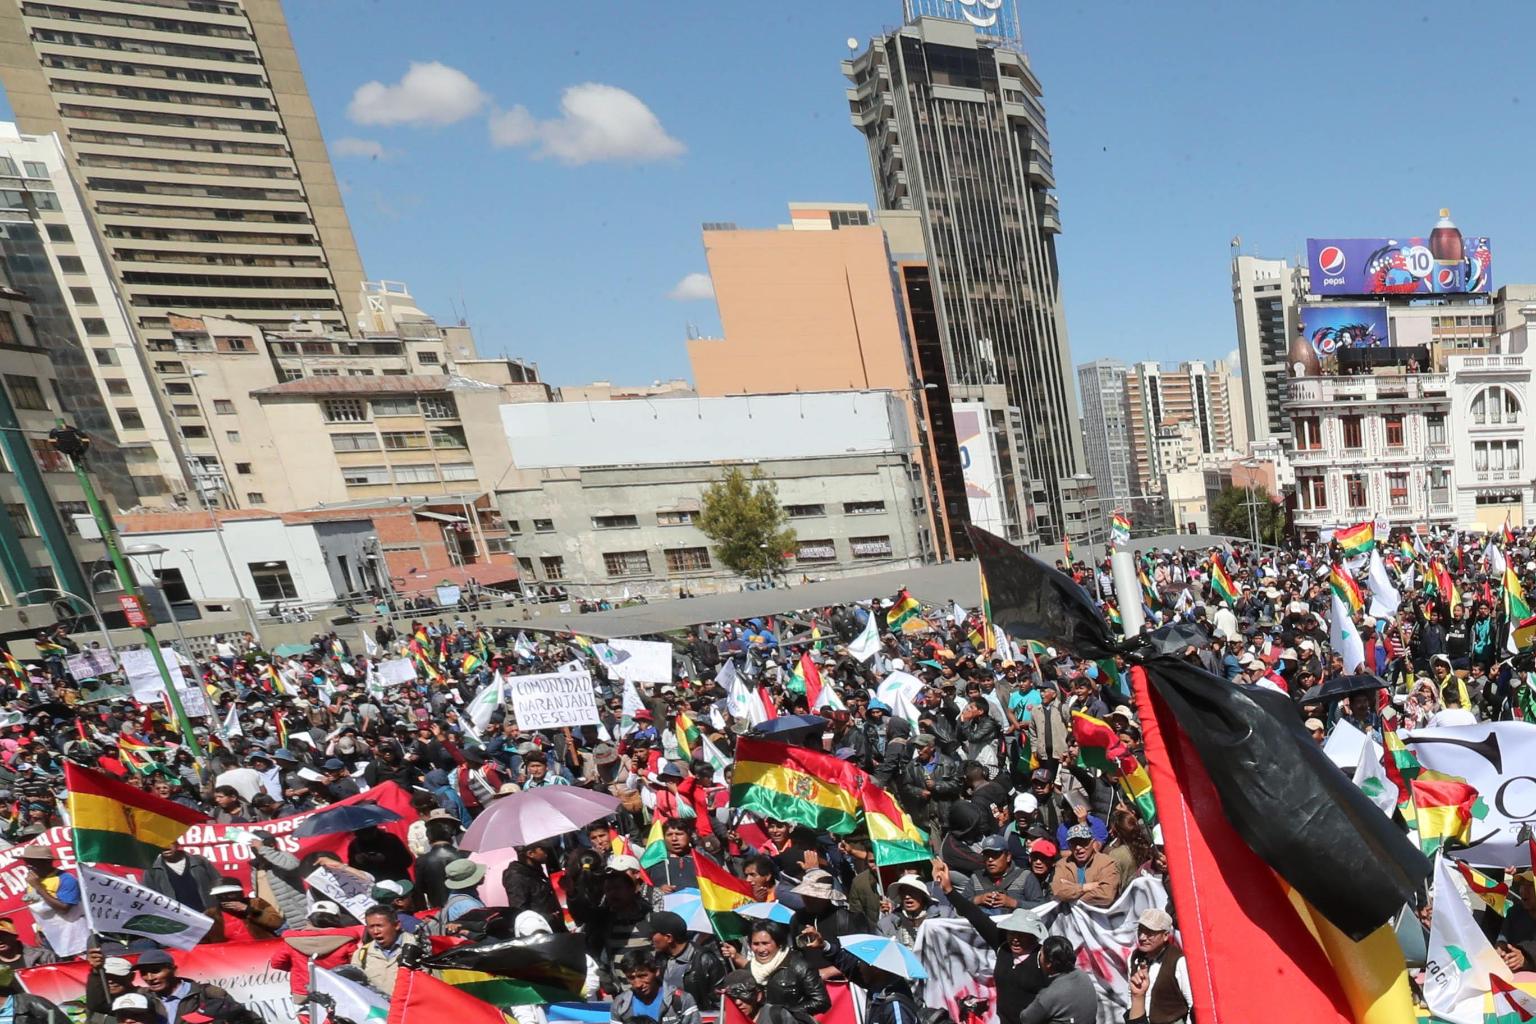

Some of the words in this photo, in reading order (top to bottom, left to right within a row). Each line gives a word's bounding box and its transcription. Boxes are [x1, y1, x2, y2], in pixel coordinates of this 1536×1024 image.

[1410, 252, 1430, 270] 10
[1323, 276, 1345, 287] pepsi
[1376, 521, 1387, 530] NO
[516, 676, 591, 696] COMUNIDAD
[522, 708, 594, 726] PRESENTE
